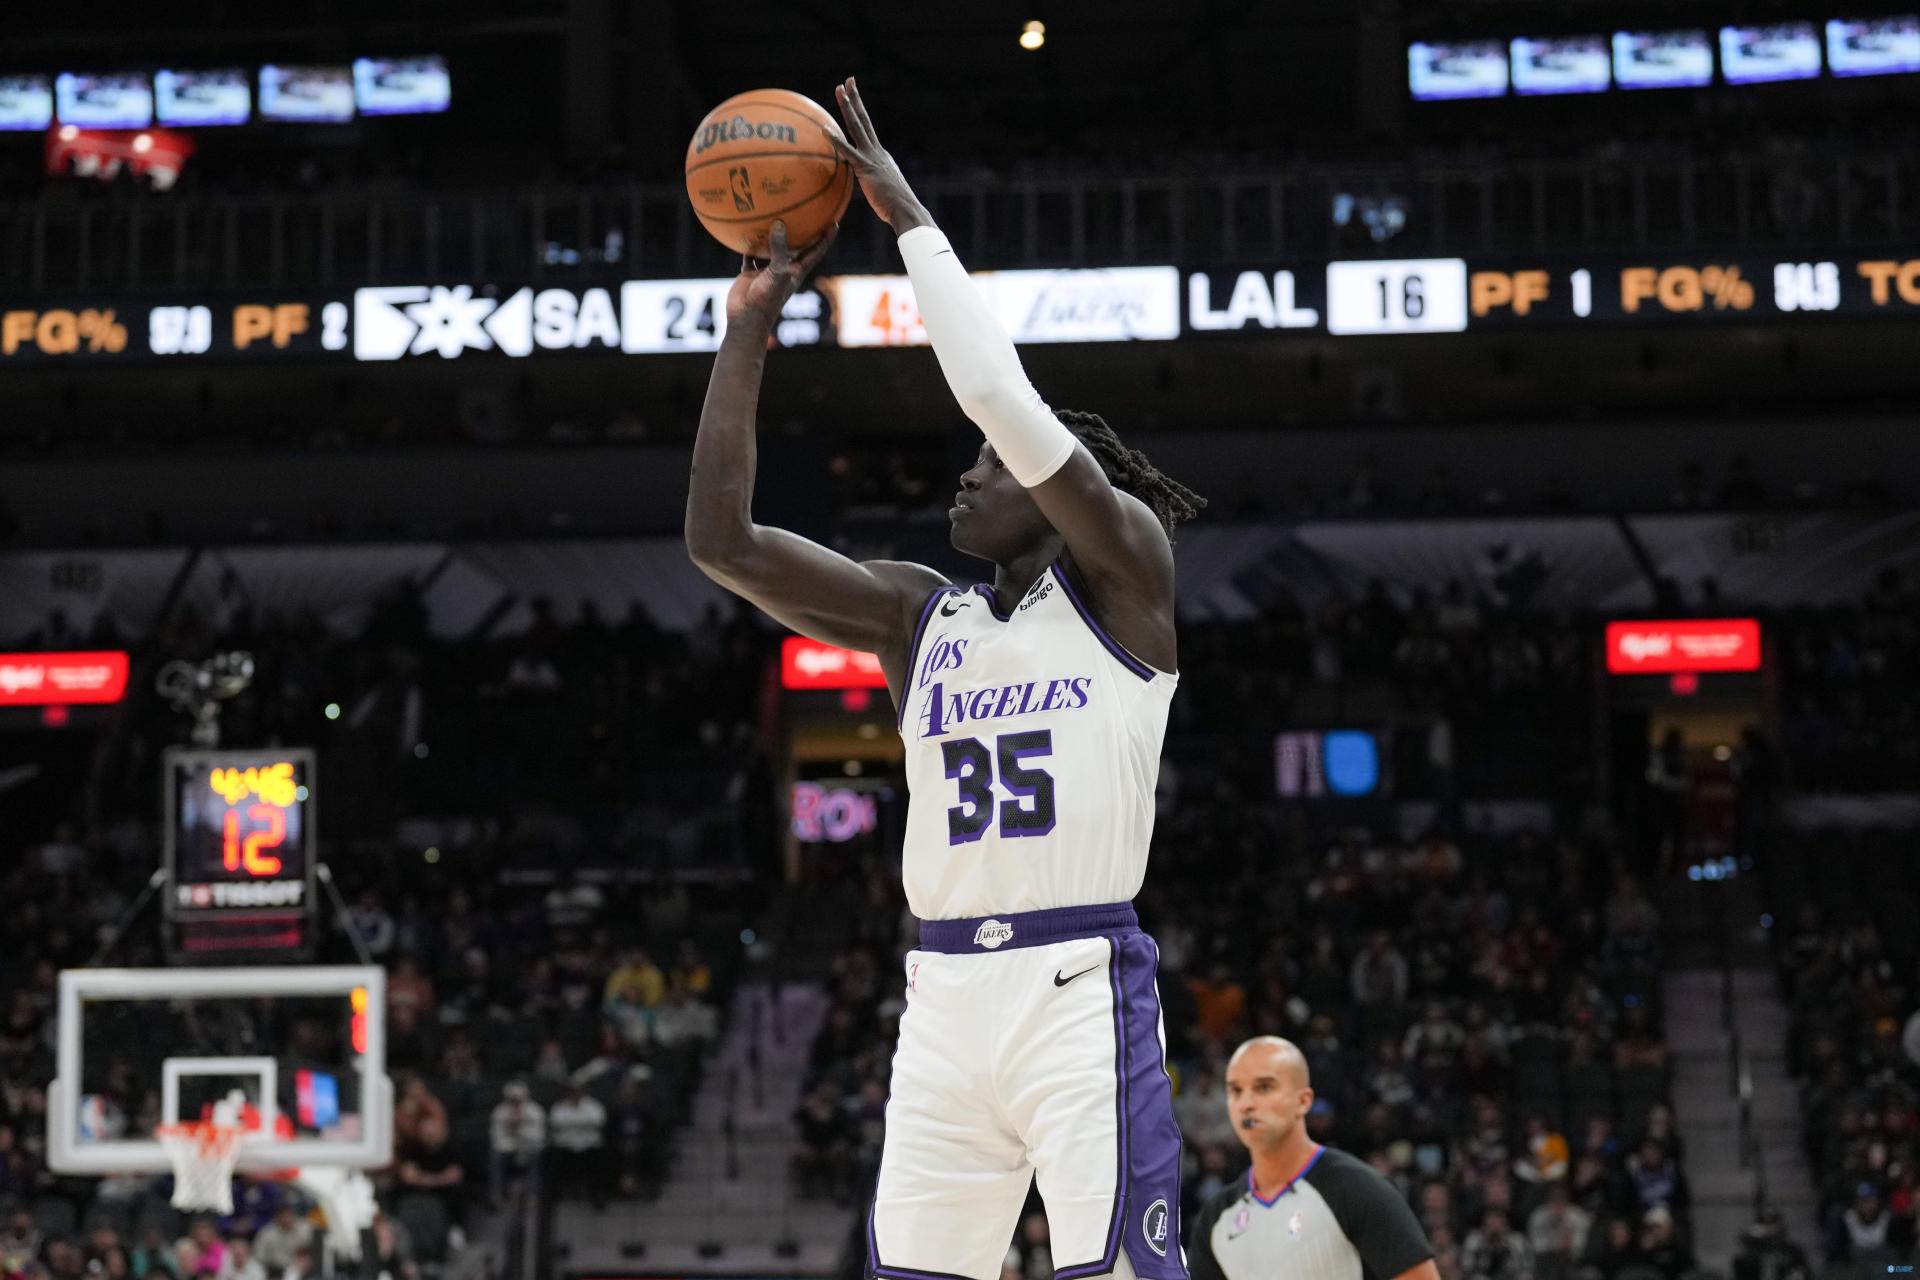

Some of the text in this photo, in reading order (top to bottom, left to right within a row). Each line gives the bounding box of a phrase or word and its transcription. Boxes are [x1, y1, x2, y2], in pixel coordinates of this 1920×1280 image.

[696, 117, 797, 154] Wilson
[534, 288, 621, 349] SA
[665, 296, 716, 339] 24
[1188, 270, 1424, 330] LAL 16
[1470, 270, 1550, 317] PF
[1570, 268, 1592, 317] 1
[1620, 264, 1754, 313] FG%
[2, 309, 128, 355] FG%
[232, 304, 308, 349] PF
[1020, 582, 1053, 611] bibigo
[917, 677, 1092, 742] ANGELES
[940, 729, 1056, 846] 35
[223, 803, 287, 876] 12
